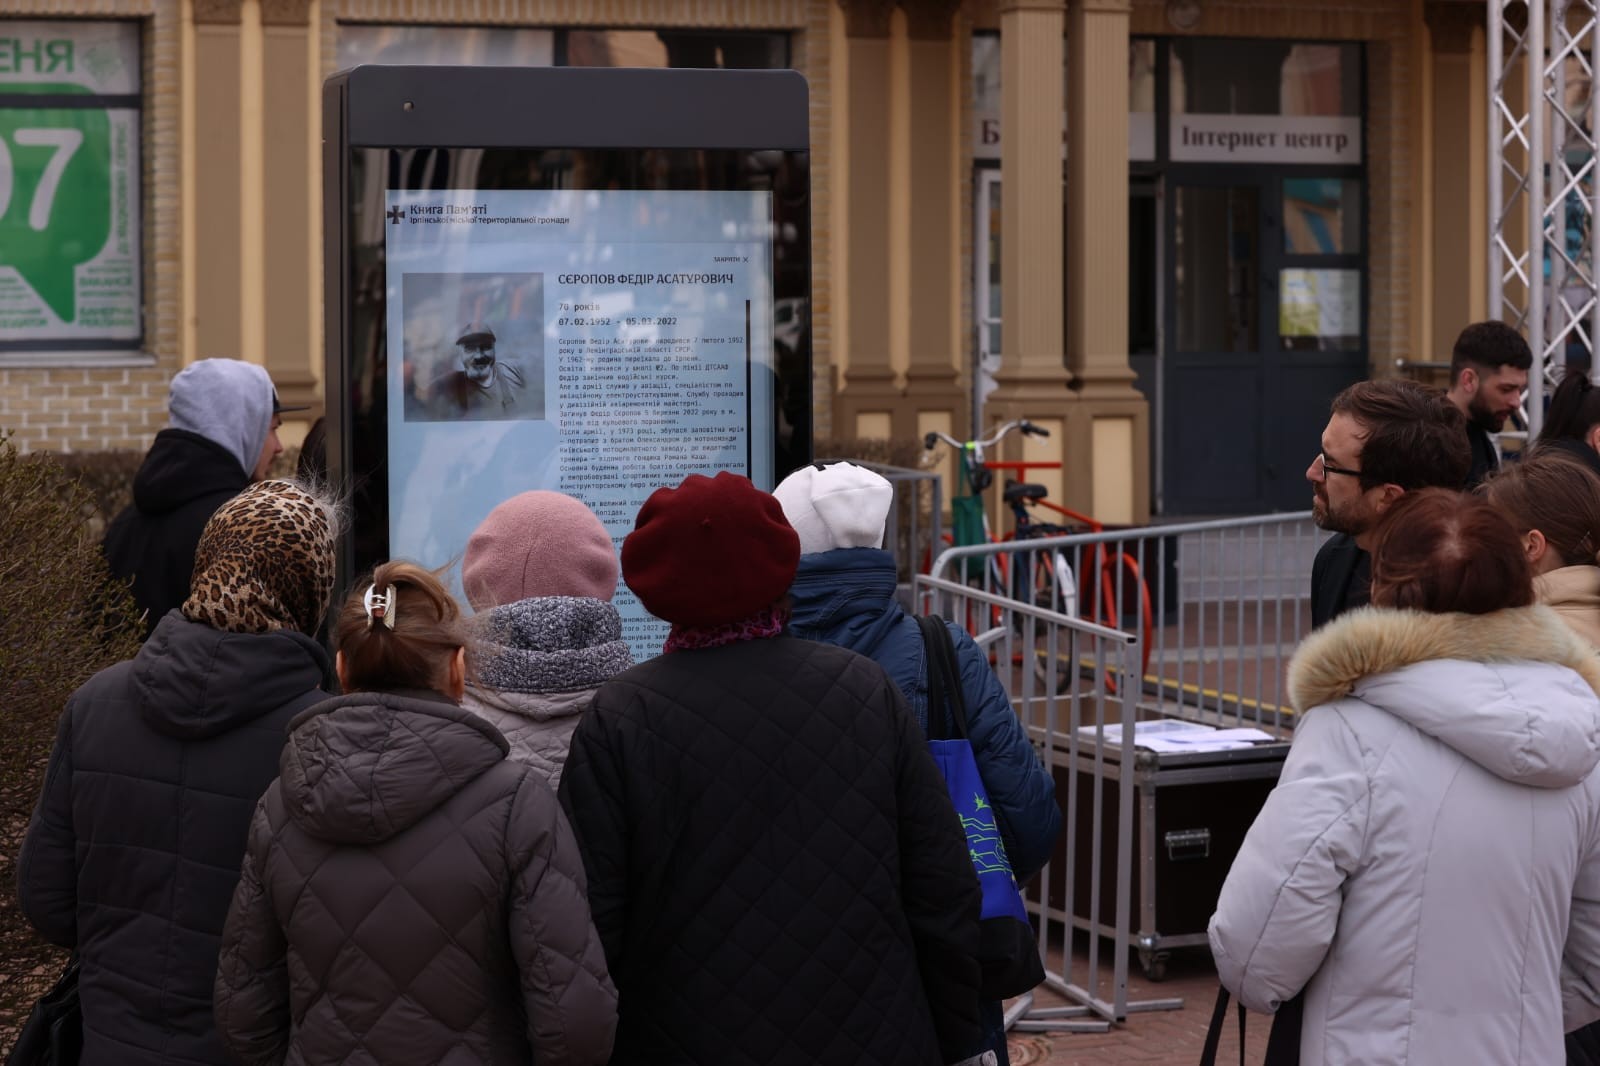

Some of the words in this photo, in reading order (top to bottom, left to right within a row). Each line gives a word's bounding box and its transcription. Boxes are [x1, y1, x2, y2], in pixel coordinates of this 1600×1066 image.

[1182, 126, 1278, 152] Інтернет
[1285, 132, 1348, 154] центр
[0, 127, 84, 232] 7
[410, 204, 443, 214] Книга
[446, 204, 488, 214] Пам'яті
[478, 216, 536, 225] територіальної
[538, 216, 570, 225] громади
[558, 273, 615, 284] СЄРОПОВ
[617, 273, 654, 286] ФЕДІР
[656, 273, 734, 284] АСАТУРОВИЧ
[574, 302, 600, 312] років
[558, 317, 611, 326] 07.02.1952
